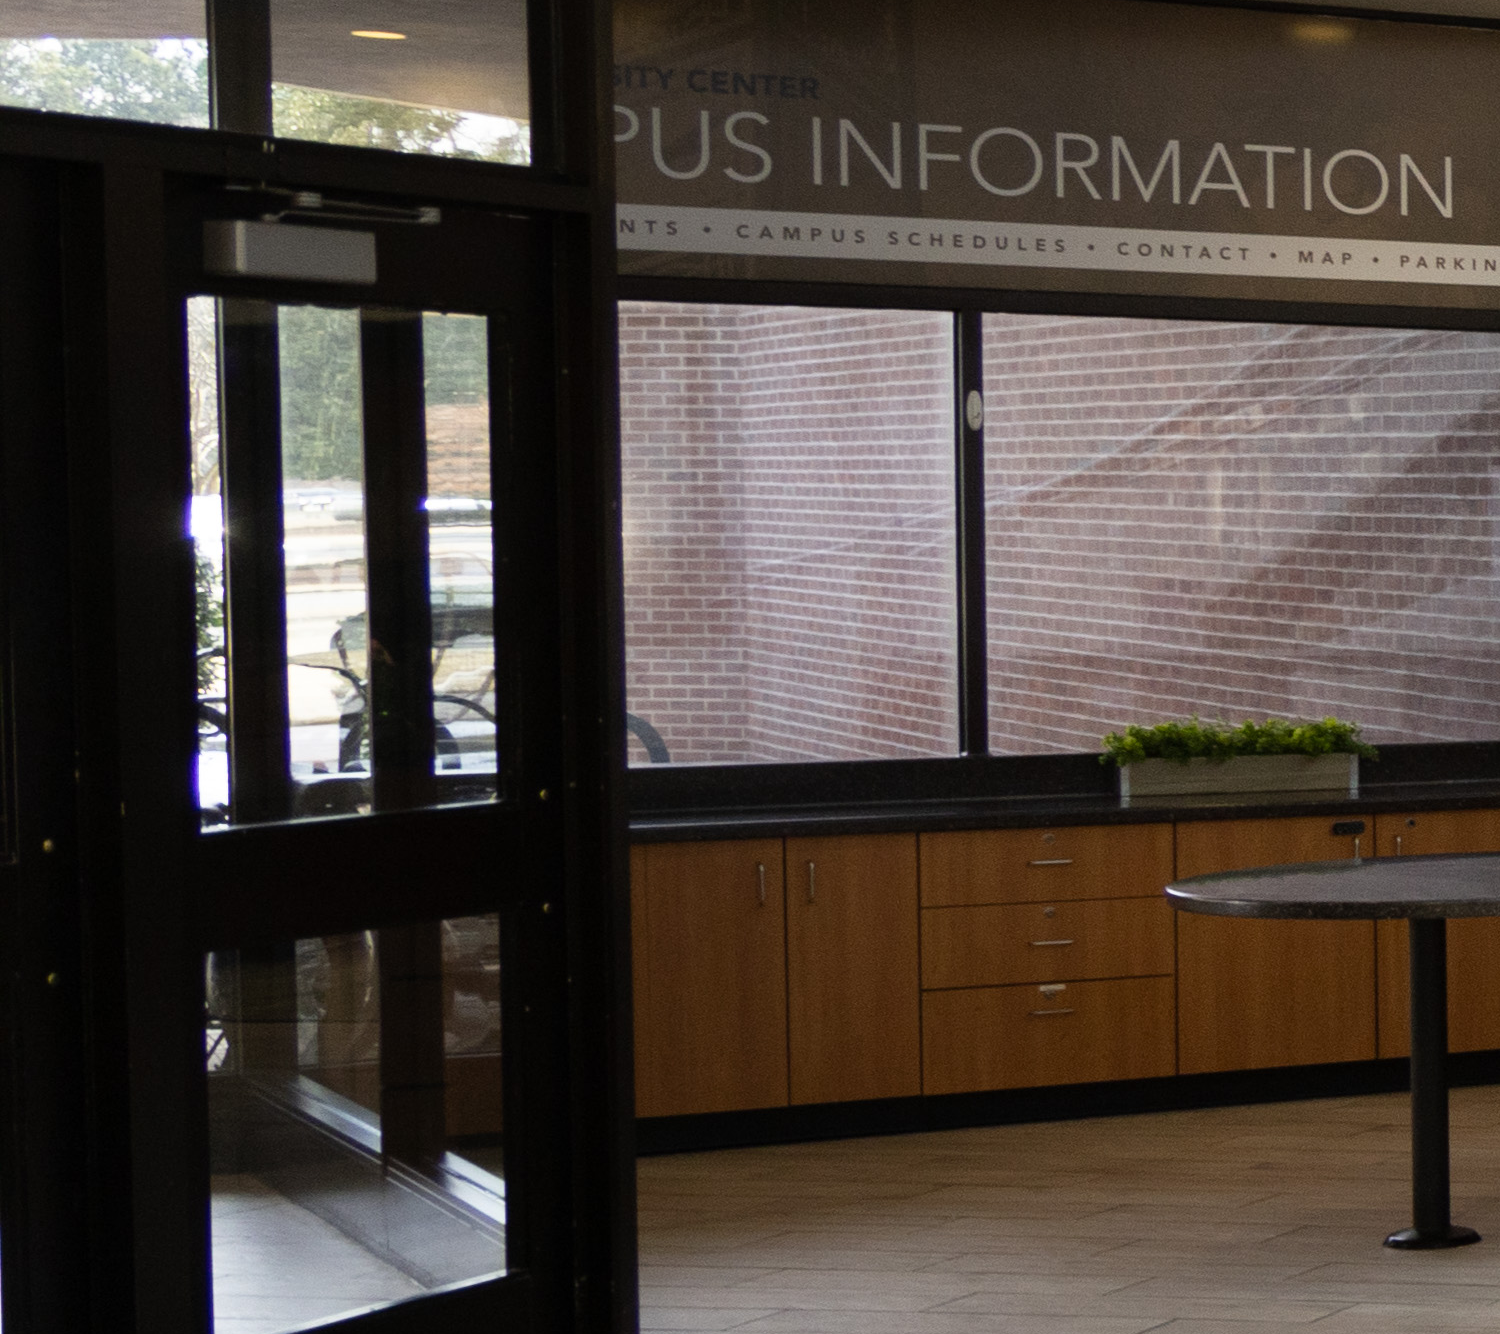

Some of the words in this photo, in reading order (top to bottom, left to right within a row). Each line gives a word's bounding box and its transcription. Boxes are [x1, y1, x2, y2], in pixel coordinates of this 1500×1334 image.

[687, 68, 820, 100] CENTER
[812, 116, 1454, 219] INFORMATION
[620, 218, 679, 236] NTS
[736, 223, 867, 245] CAMPUS
[887, 230, 1067, 254] SCHEDULES
[1116, 241, 1252, 262] CONTACT
[1298, 249, 1354, 267] MAP
